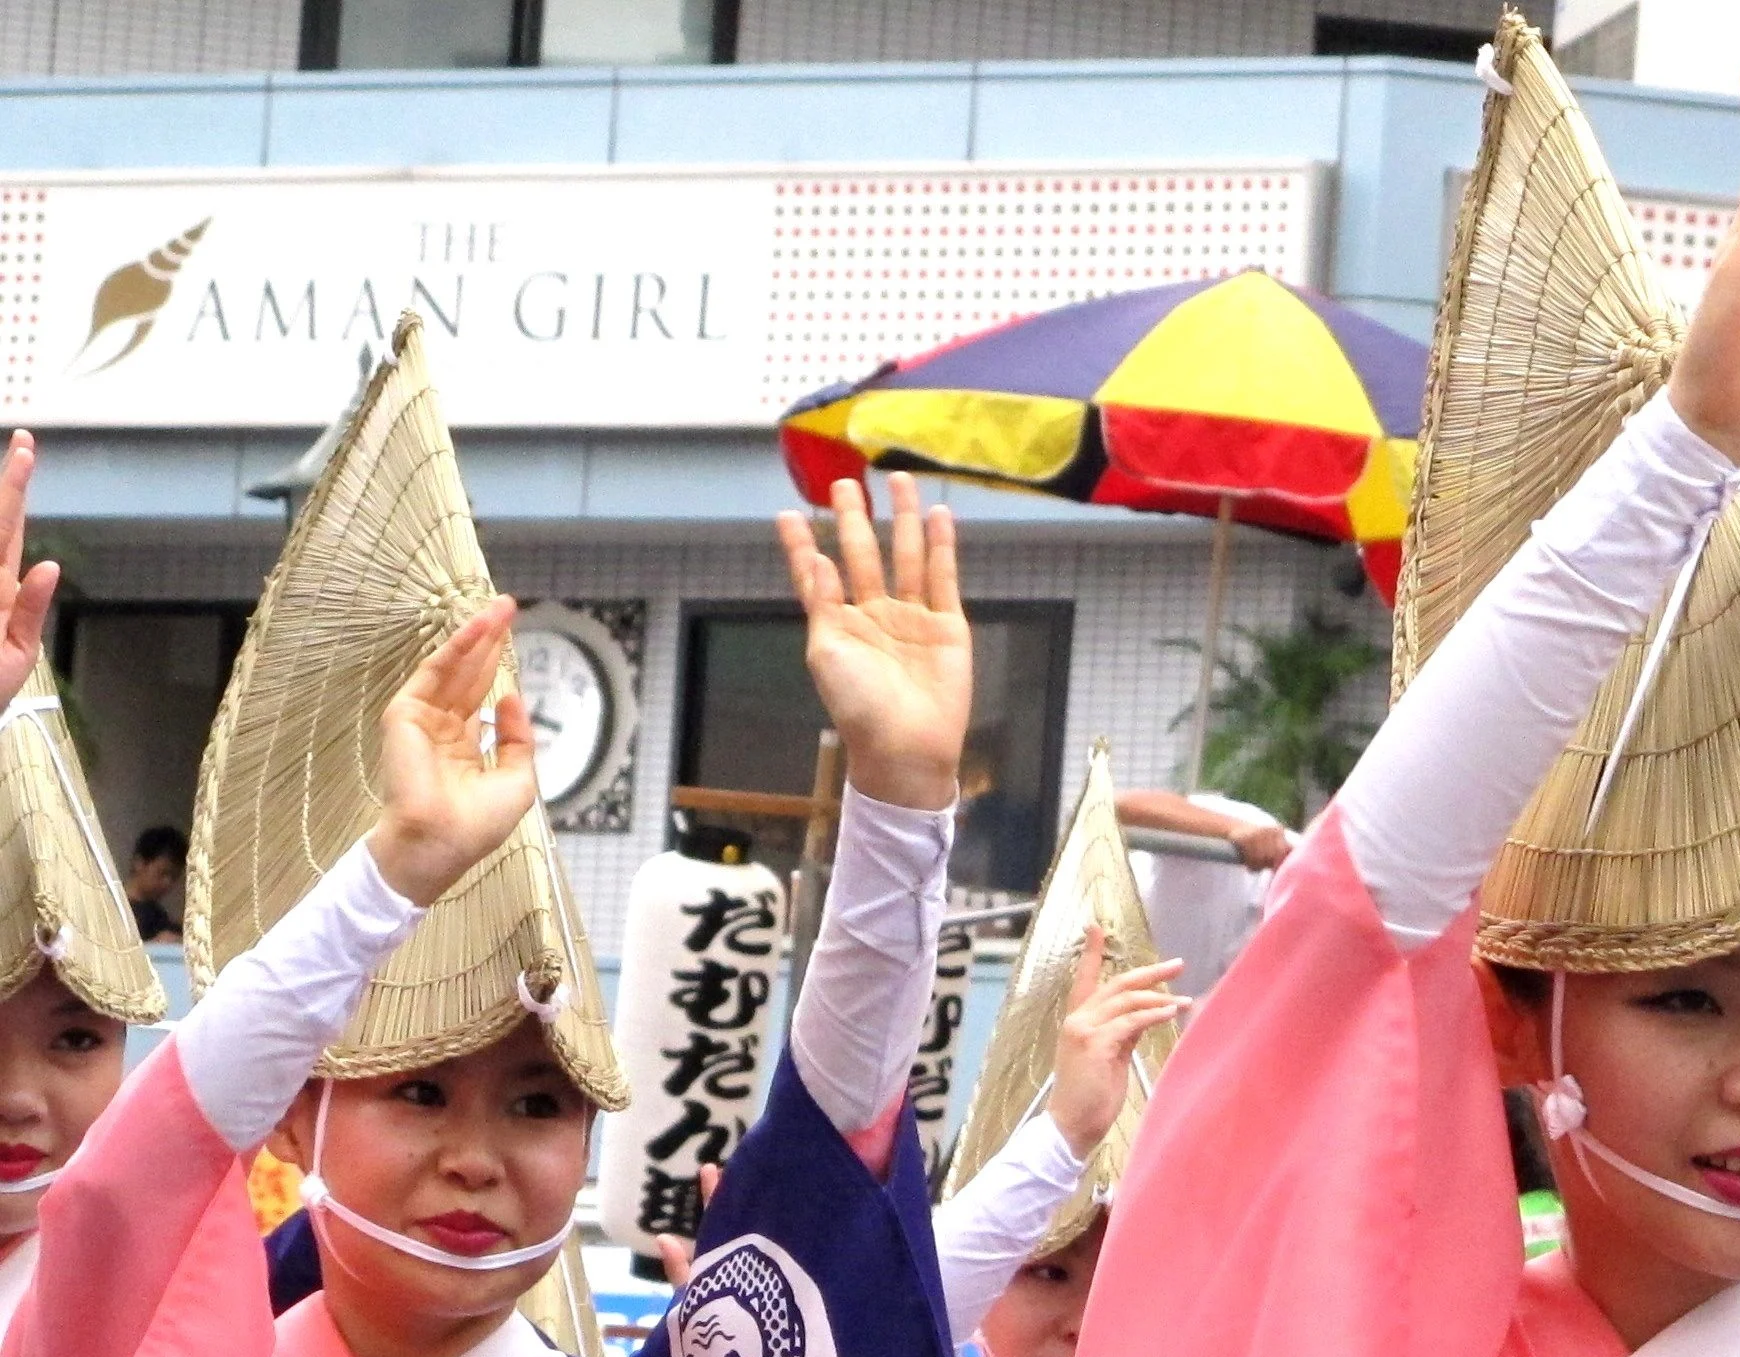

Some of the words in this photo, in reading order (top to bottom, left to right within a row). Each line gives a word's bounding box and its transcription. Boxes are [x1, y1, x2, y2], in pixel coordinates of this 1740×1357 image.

[413, 221, 510, 263] THE
[187, 273, 464, 341] AMAN
[512, 270, 728, 342] GIRL
